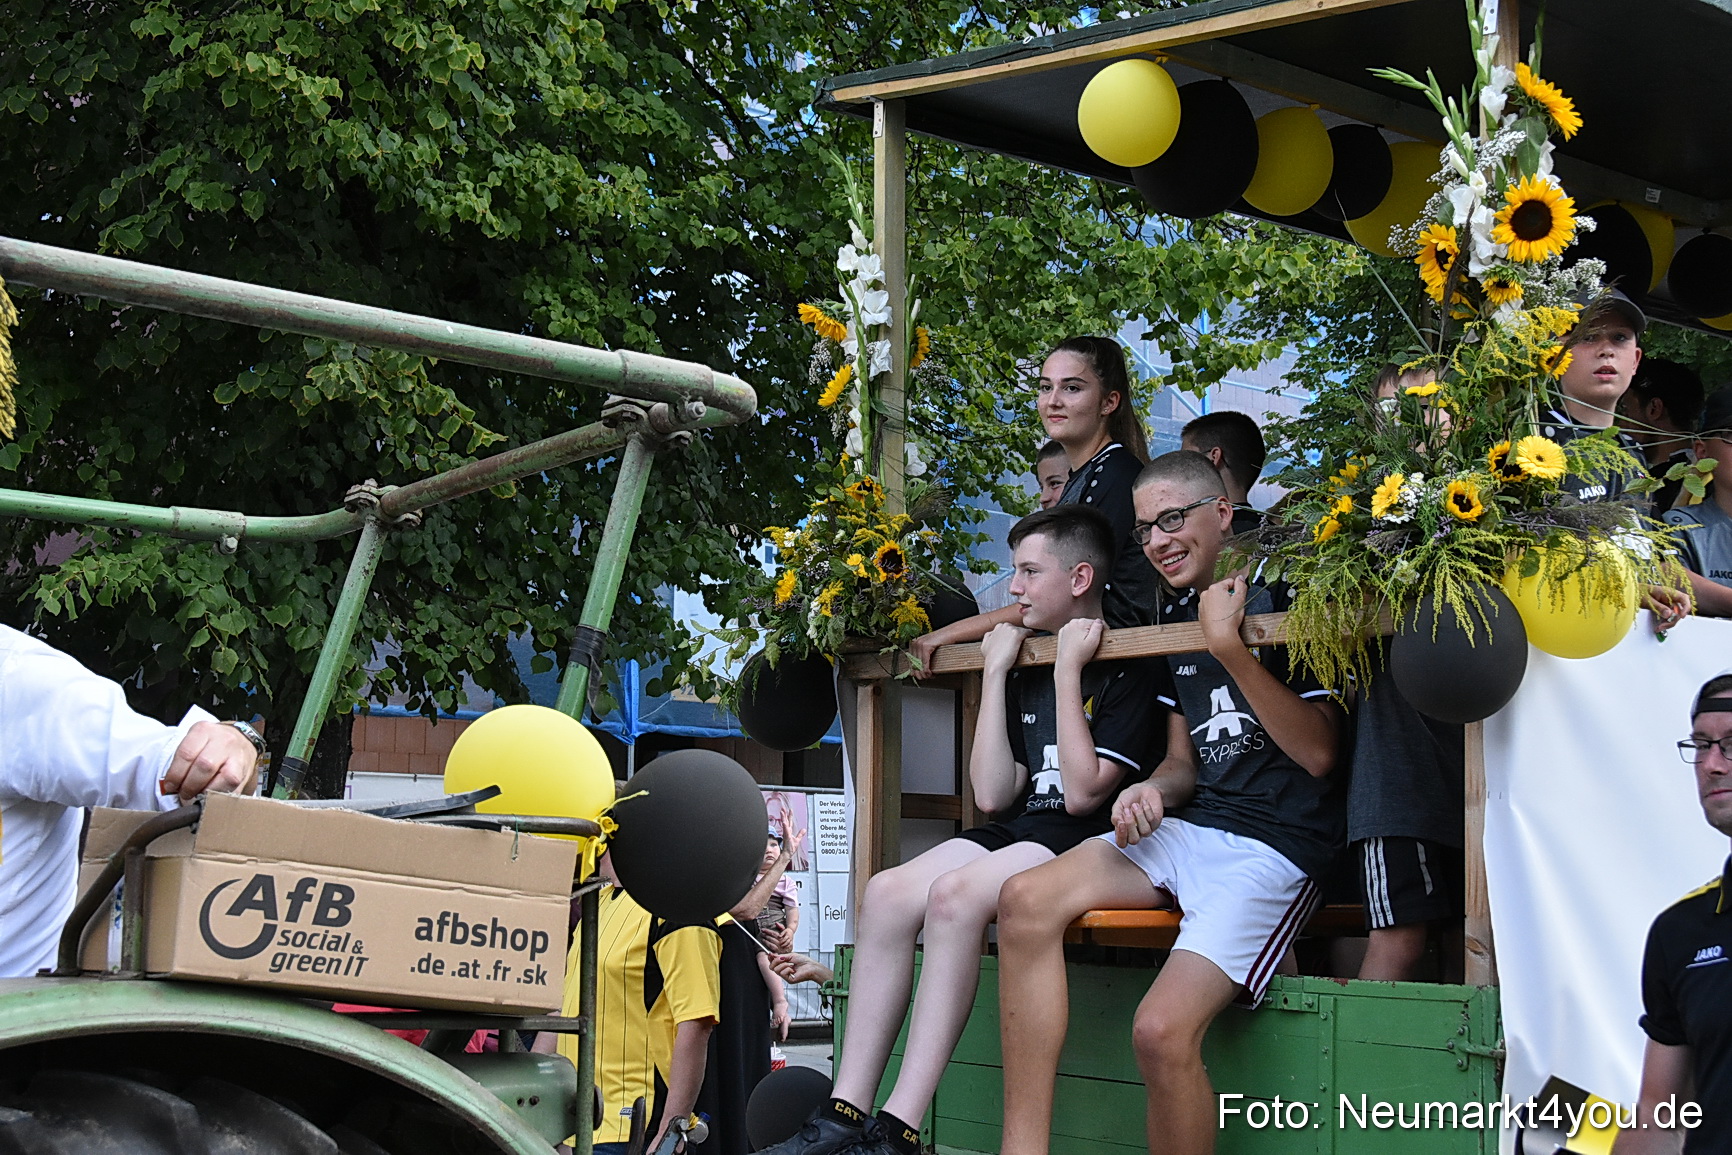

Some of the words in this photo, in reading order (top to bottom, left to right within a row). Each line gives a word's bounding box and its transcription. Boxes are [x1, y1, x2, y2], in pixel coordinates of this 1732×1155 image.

[1578, 484, 1607, 500] JAKO
[1175, 664, 1198, 676] JAK
[225, 873, 356, 928] AfB
[276, 929, 351, 953] social
[351, 939, 364, 955] &
[414, 910, 549, 961] afbshop
[1693, 945, 1722, 962] JAKO
[410, 952, 445, 976] .de
[451, 959, 481, 979] .at
[486, 959, 511, 982] .fr
[516, 964, 548, 986] .sk
[834, 1101, 860, 1121] CAT
[902, 1129, 919, 1145] CA
